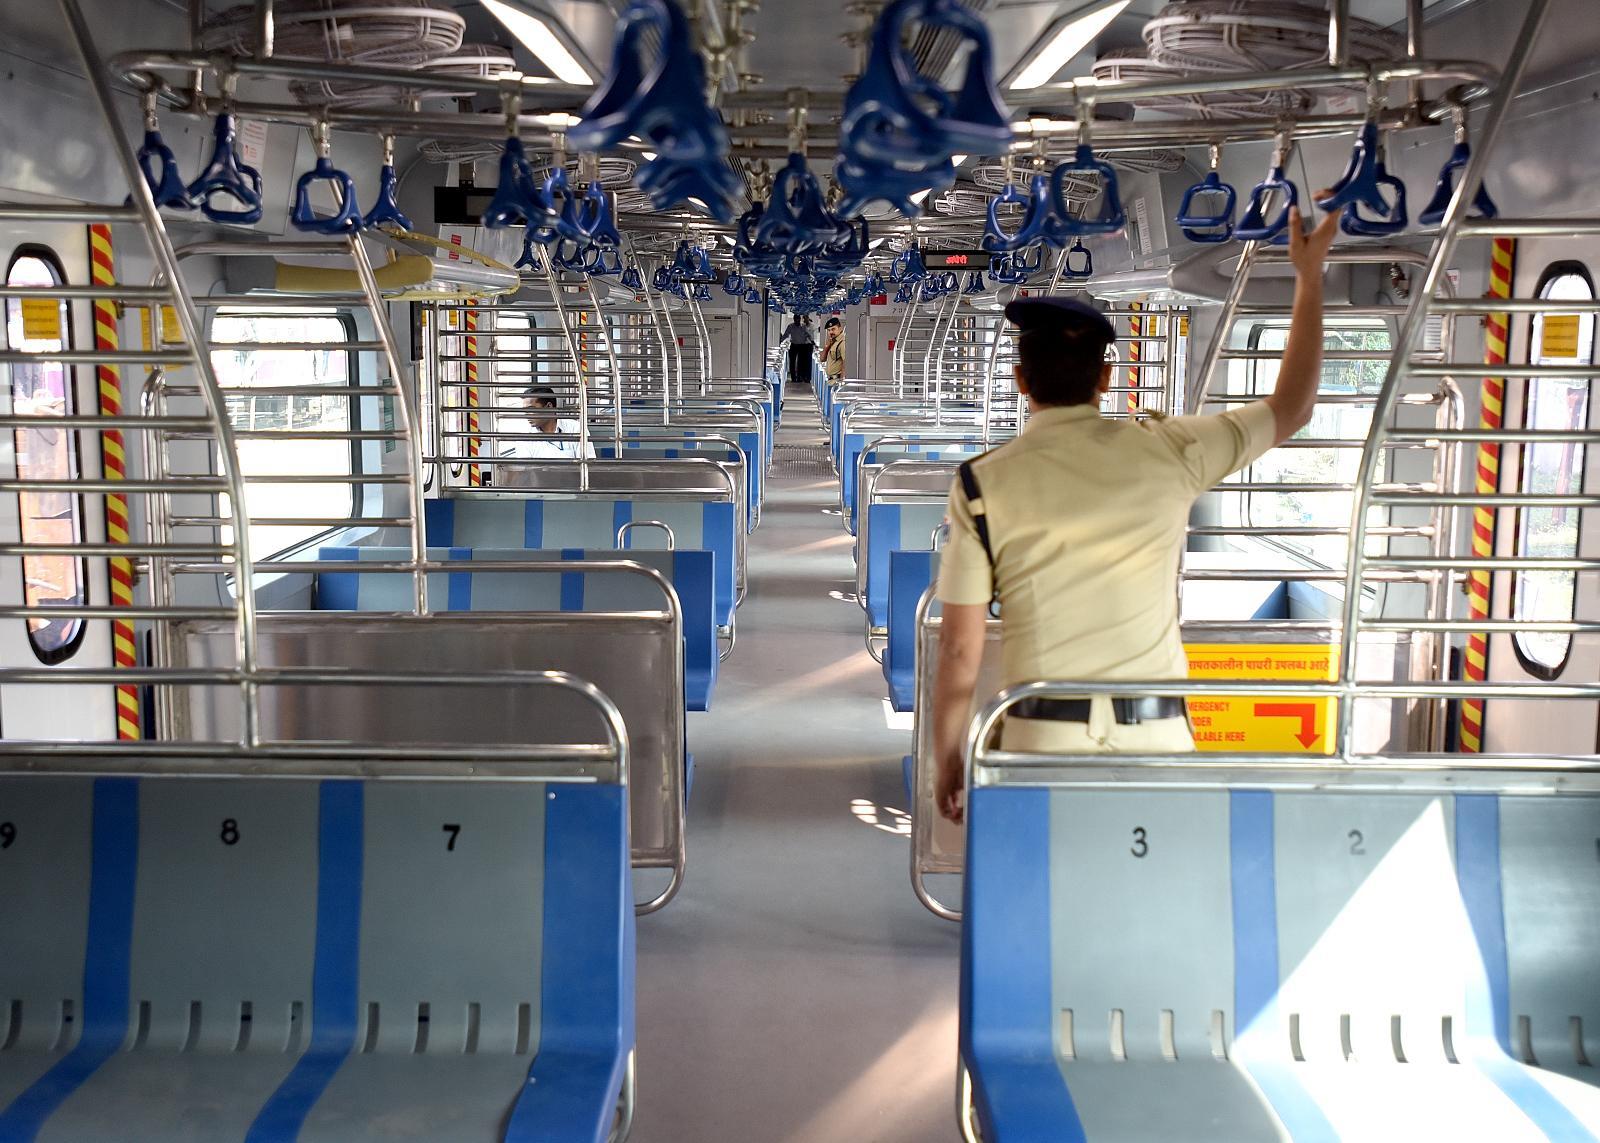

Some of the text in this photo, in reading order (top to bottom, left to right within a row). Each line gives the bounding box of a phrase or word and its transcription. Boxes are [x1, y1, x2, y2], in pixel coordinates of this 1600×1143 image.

[1310, 657, 1329, 671] आहे
[1188, 701, 1230, 711] MERGENCY
[1225, 731, 1246, 741] HERE
[0, 821, 17, 849] 9
[221, 818, 240, 845] 8
[443, 824, 461, 851] 7
[1131, 826, 1148, 858] 3
[1348, 829, 1366, 855] 2
